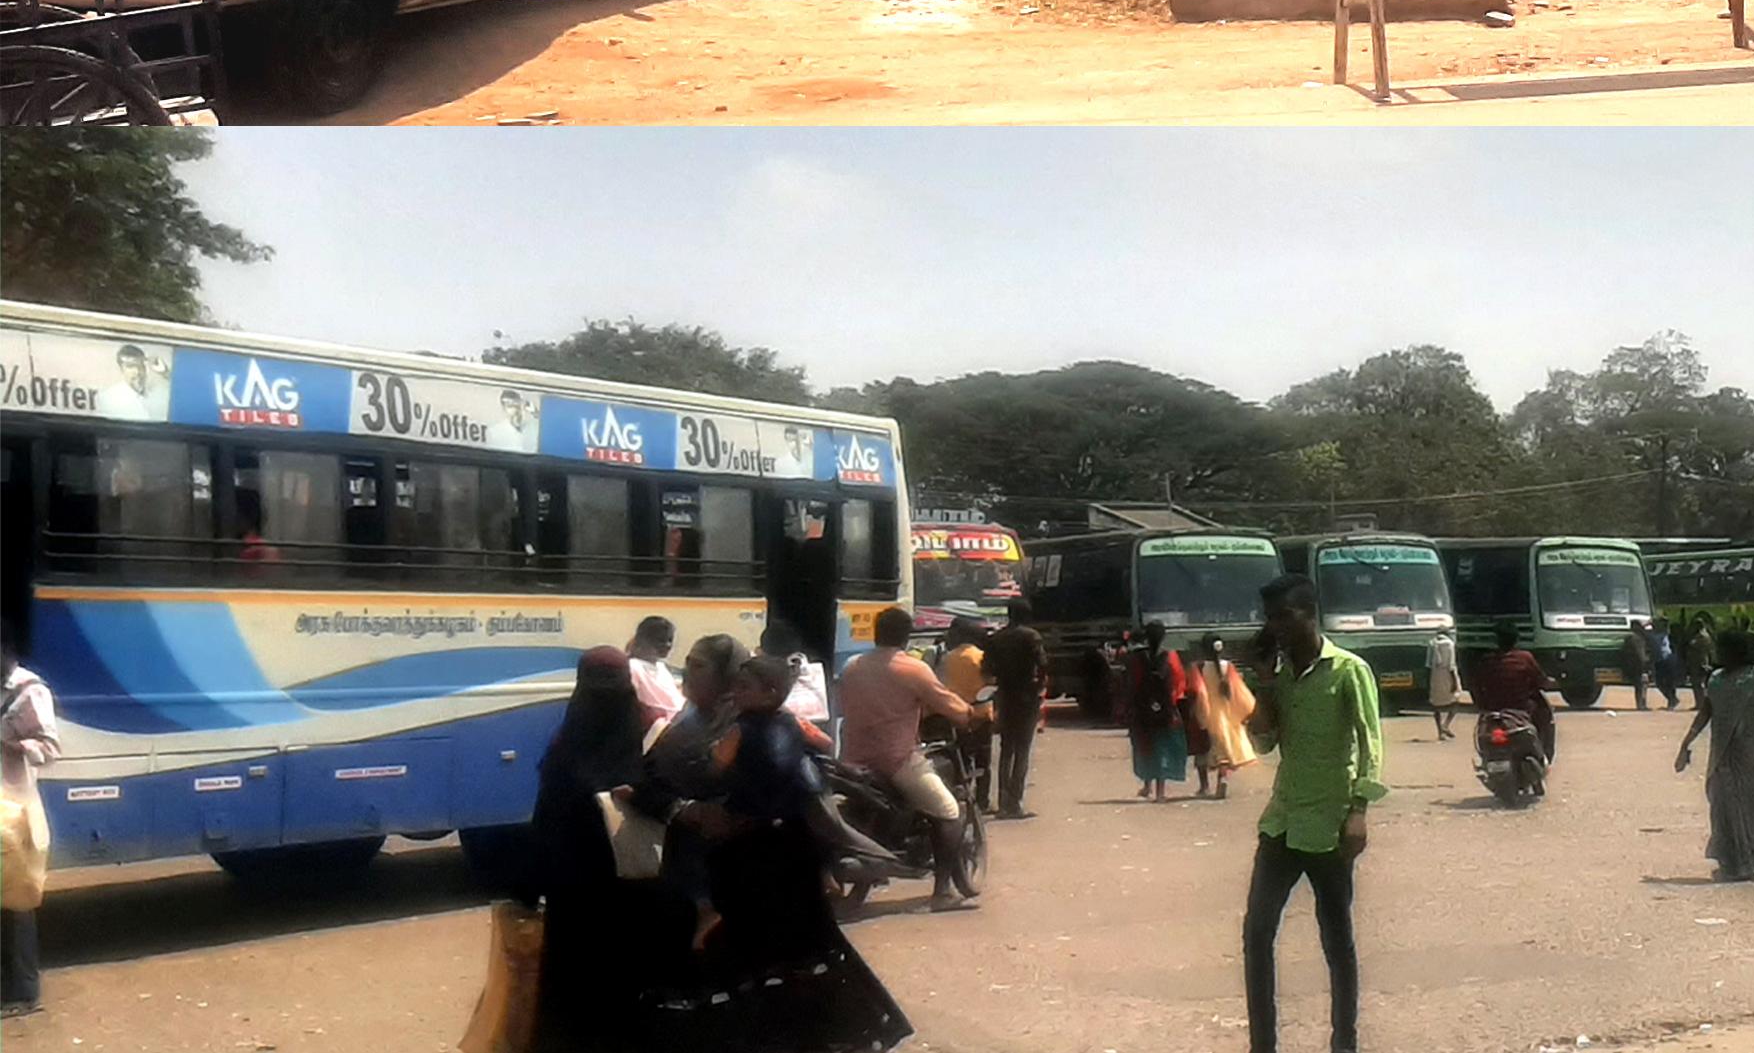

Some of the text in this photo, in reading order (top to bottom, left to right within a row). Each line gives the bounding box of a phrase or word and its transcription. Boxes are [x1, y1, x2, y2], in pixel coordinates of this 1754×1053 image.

[213, 358, 300, 411] KAG
[221, 408, 300, 427] TILES
[581, 405, 643, 451] KAG
